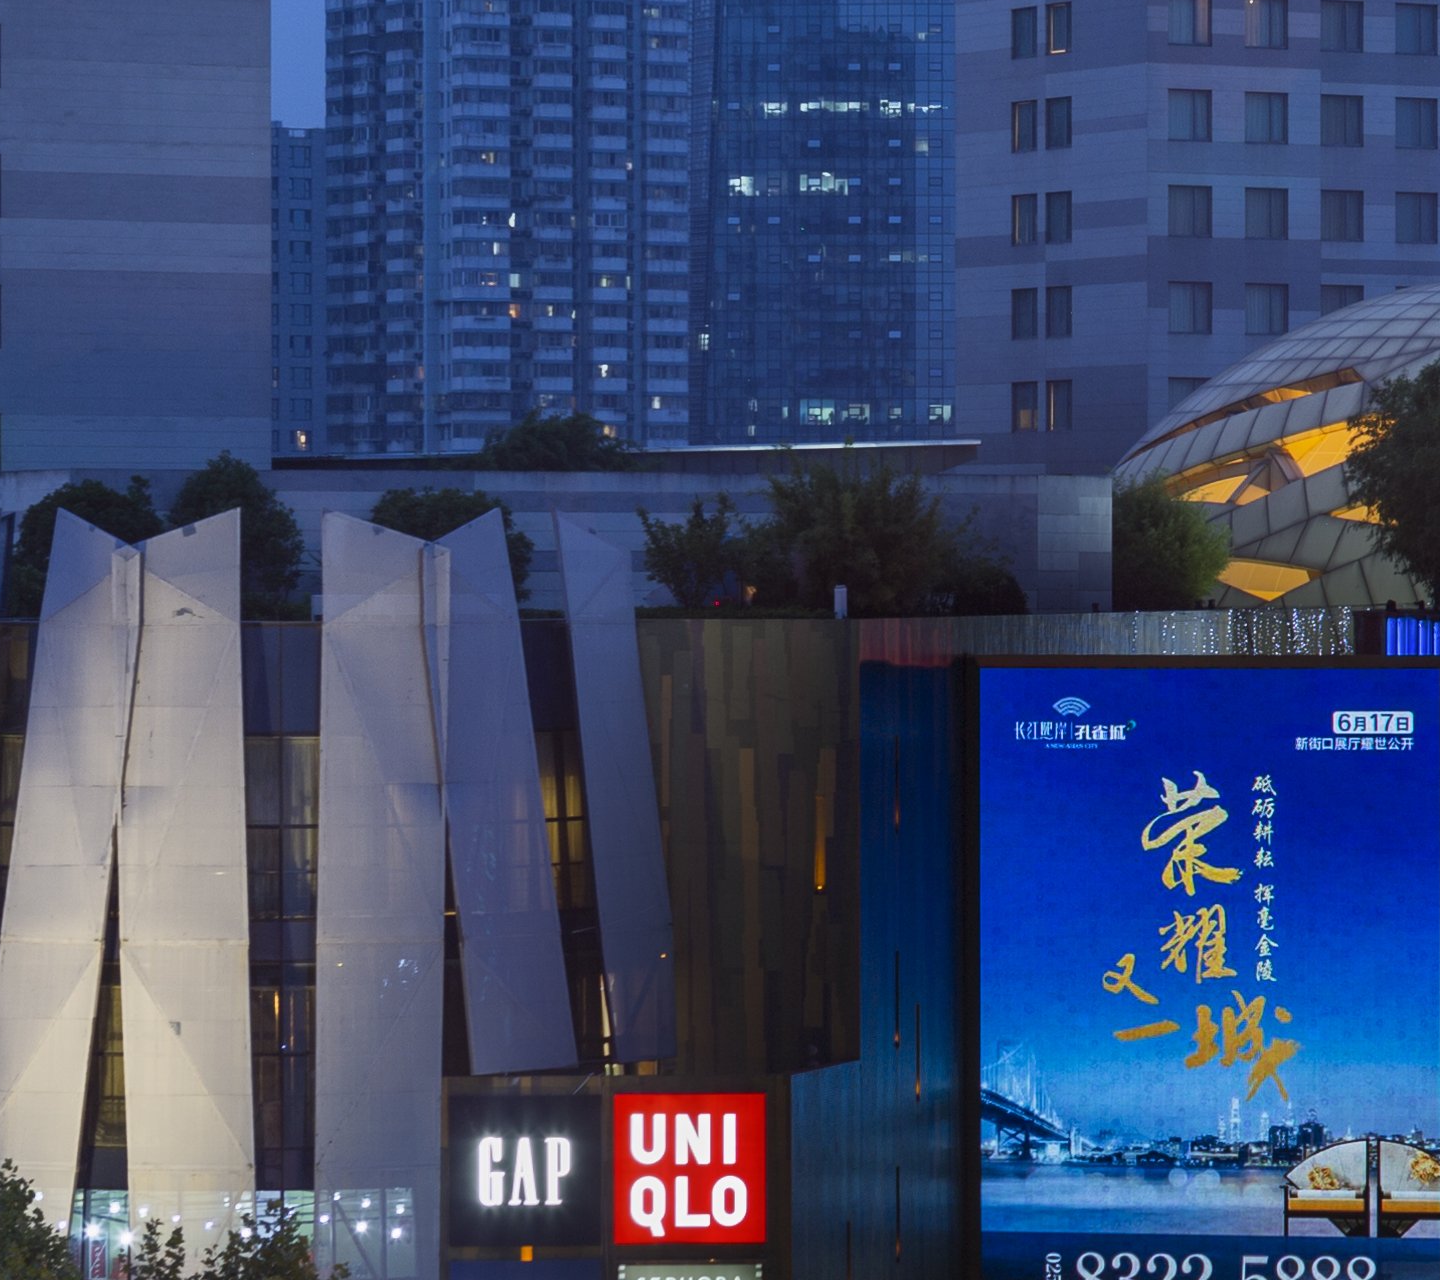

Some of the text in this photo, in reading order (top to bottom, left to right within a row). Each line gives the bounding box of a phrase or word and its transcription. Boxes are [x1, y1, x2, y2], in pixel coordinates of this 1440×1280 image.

[1295, 736, 1415, 751] 新街口展厅耀世公开
[1337, 713, 1410, 732] 6月17日
[1251, 774, 1279, 982] 砥砺耕耘 挥毫金陵
[629, 1113, 737, 1165] UNI
[477, 1136, 572, 1207] GAP
[629, 1175, 748, 1237] QLO
